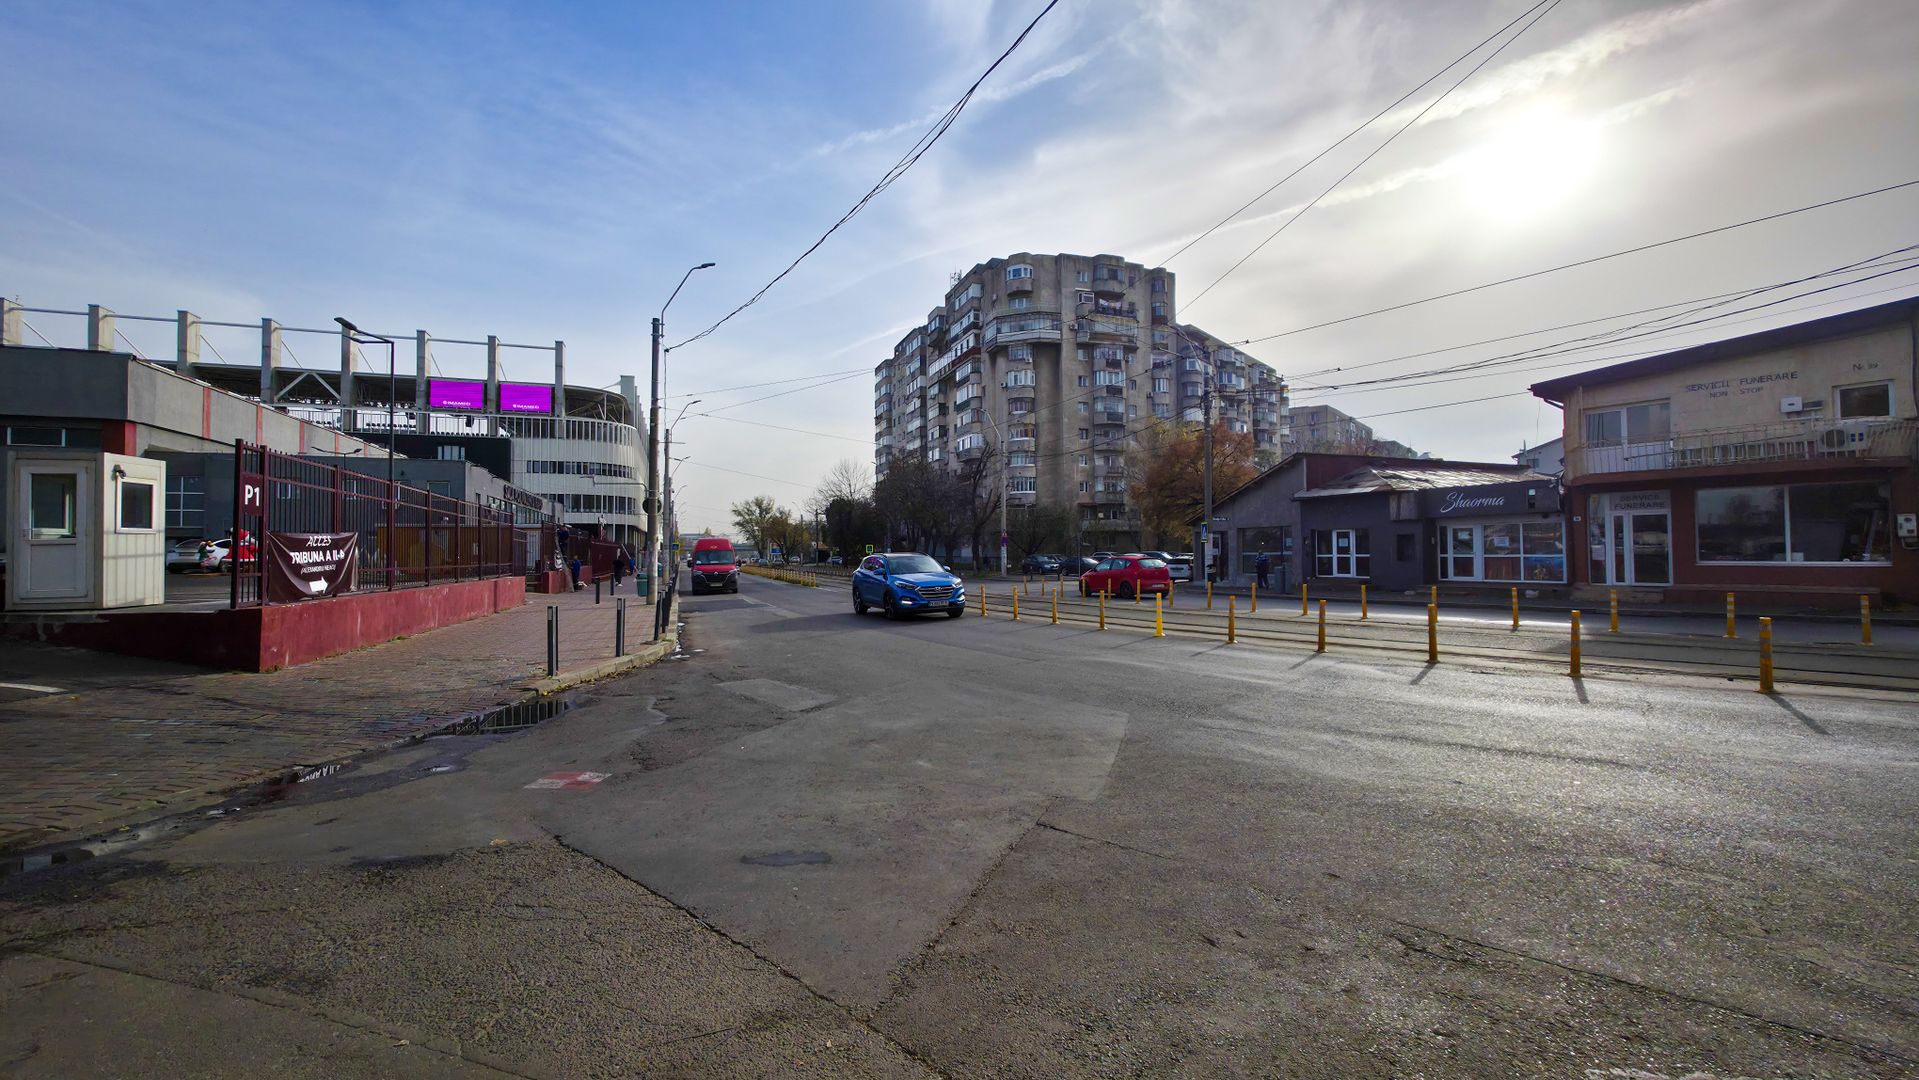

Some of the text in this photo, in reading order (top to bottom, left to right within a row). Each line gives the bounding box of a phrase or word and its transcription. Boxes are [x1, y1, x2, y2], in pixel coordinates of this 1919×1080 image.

[1740, 371, 1798, 386] FUNERARE
[1710, 386, 1764, 398] NON STOP
[244, 484, 260, 507] P1
[1440, 491, 1505, 513] Shaorma
[1614, 502, 1665, 510] FUNERARE
[306, 536, 331, 546] ACCES
[290, 551, 325, 564] TRIBUNA
[326, 550, 332, 561] A
